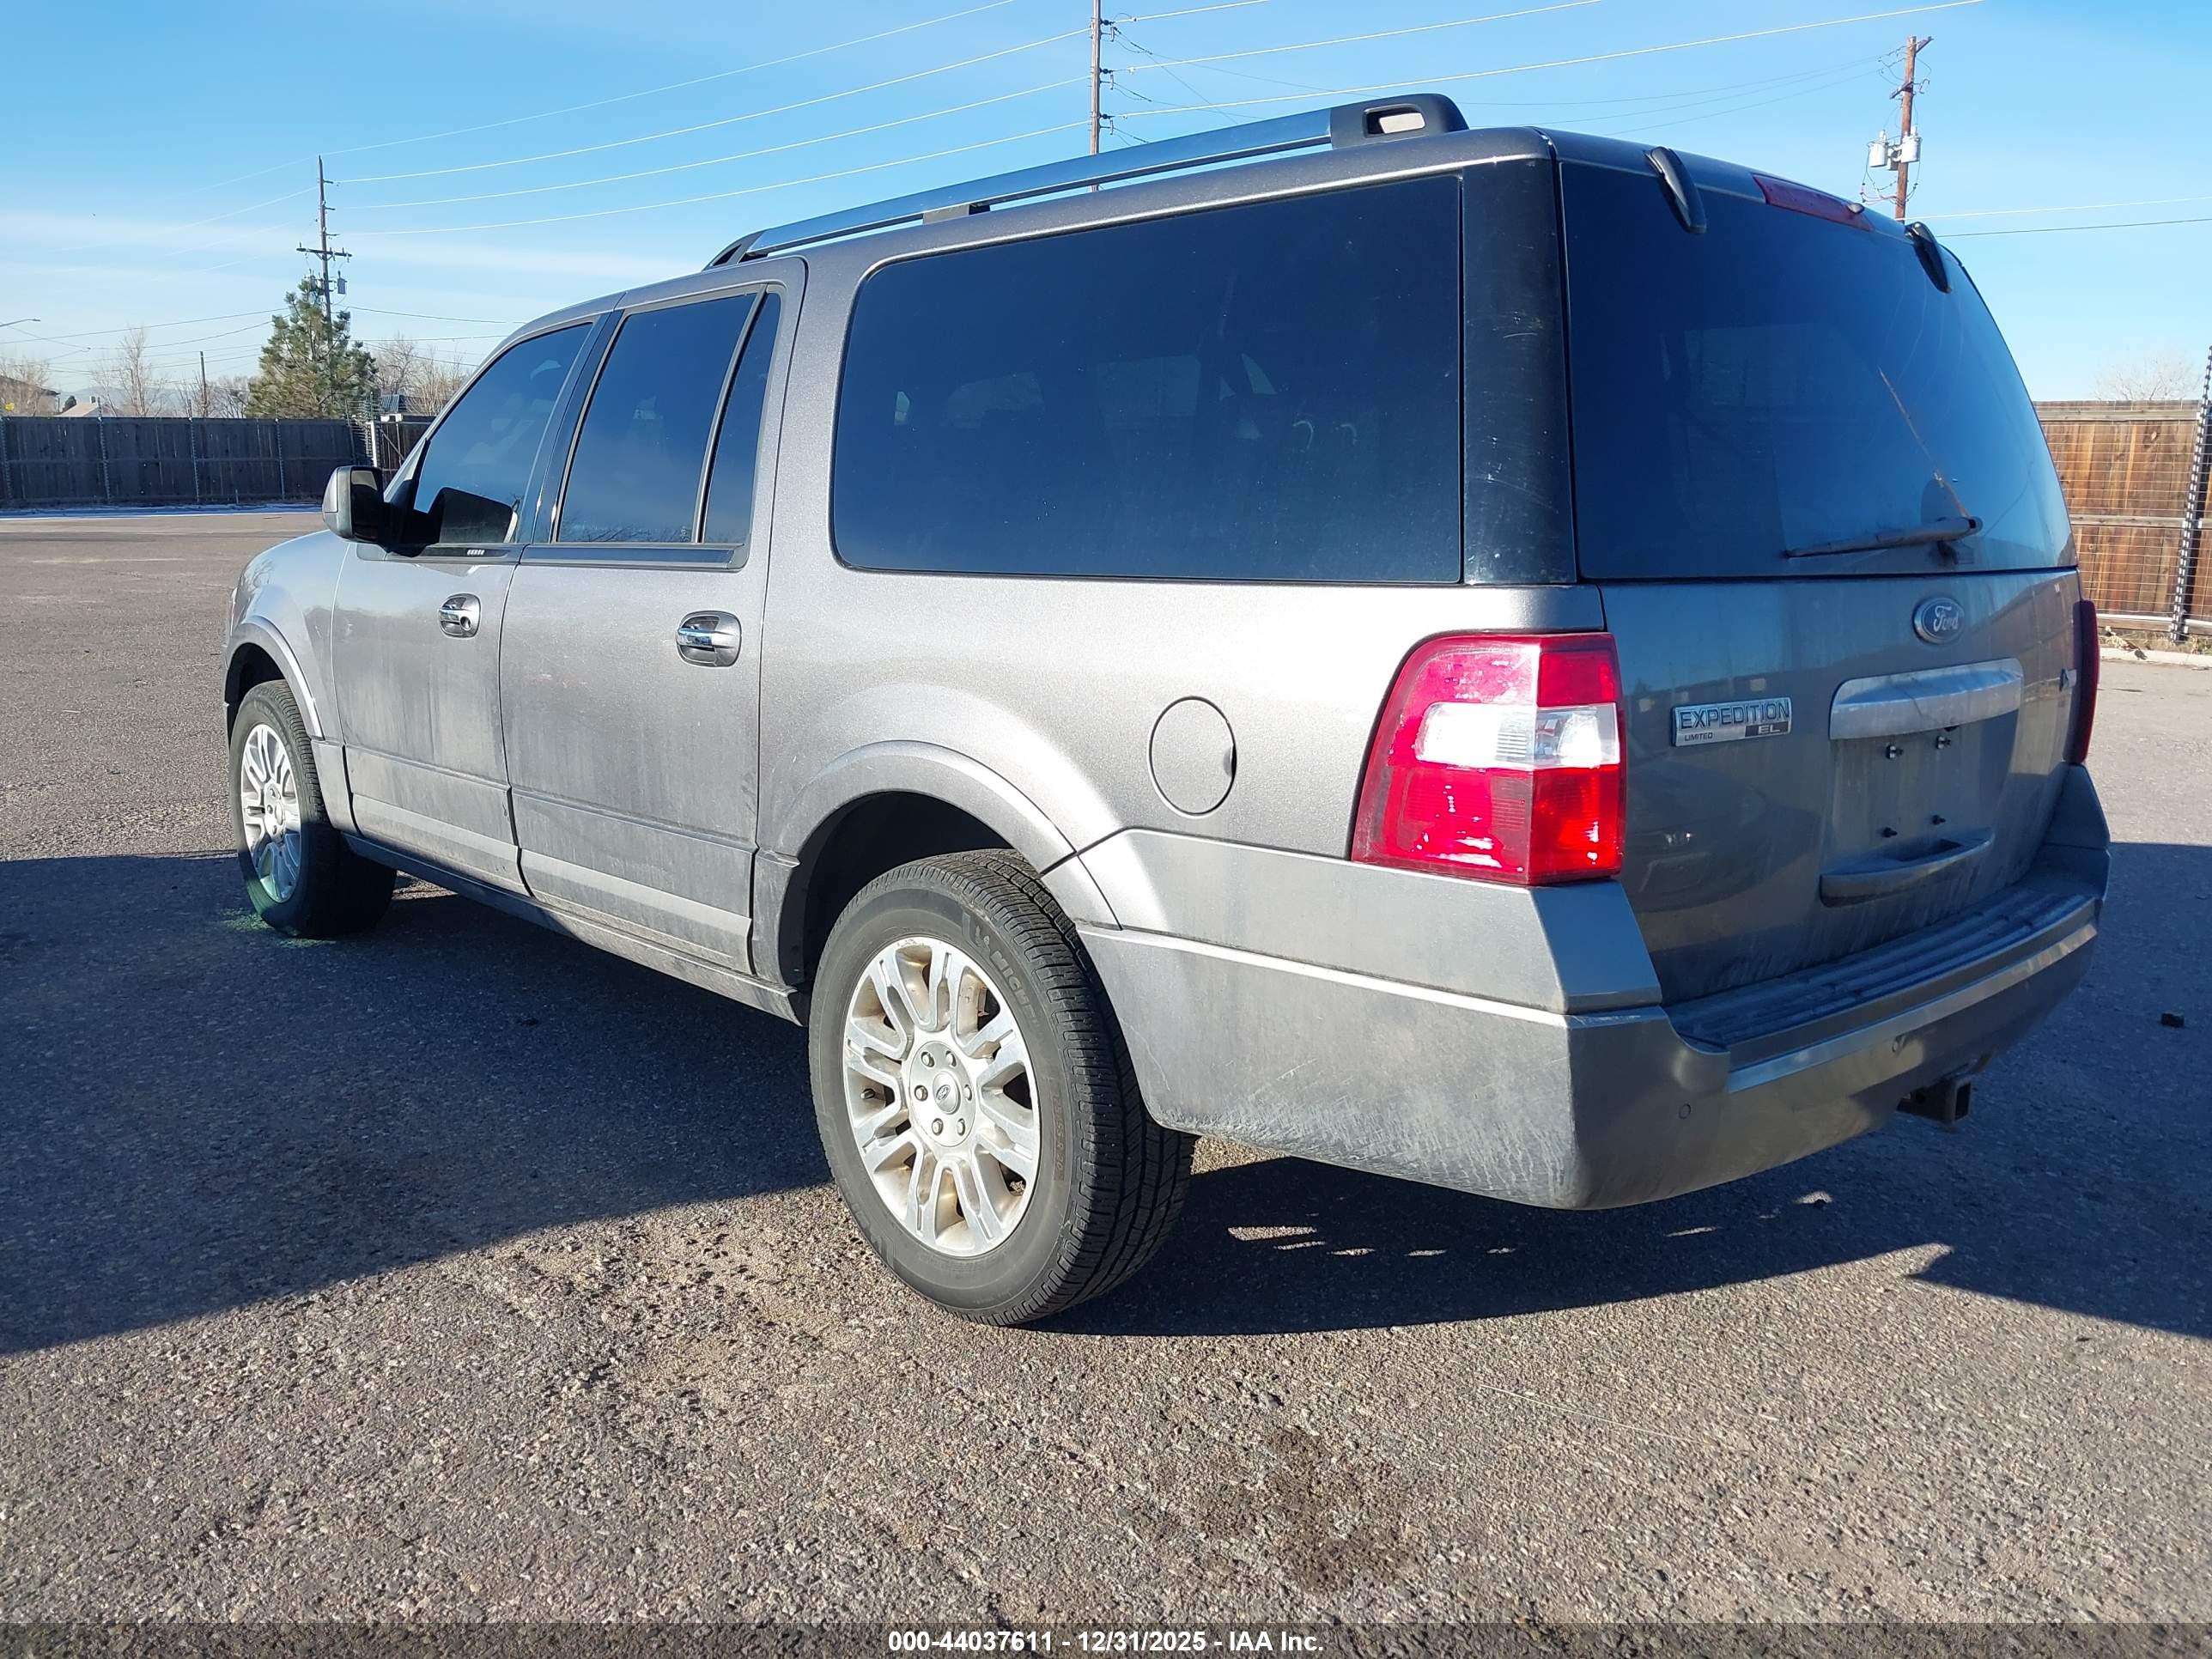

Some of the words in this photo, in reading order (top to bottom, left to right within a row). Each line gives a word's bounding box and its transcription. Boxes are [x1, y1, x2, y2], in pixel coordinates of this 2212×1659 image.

[1933, 605, 1959, 632] Ford
[1680, 701, 1790, 729] EXPEDITION
[1684, 732, 1713, 742] LIMITED
[1758, 723, 1781, 734] EL
